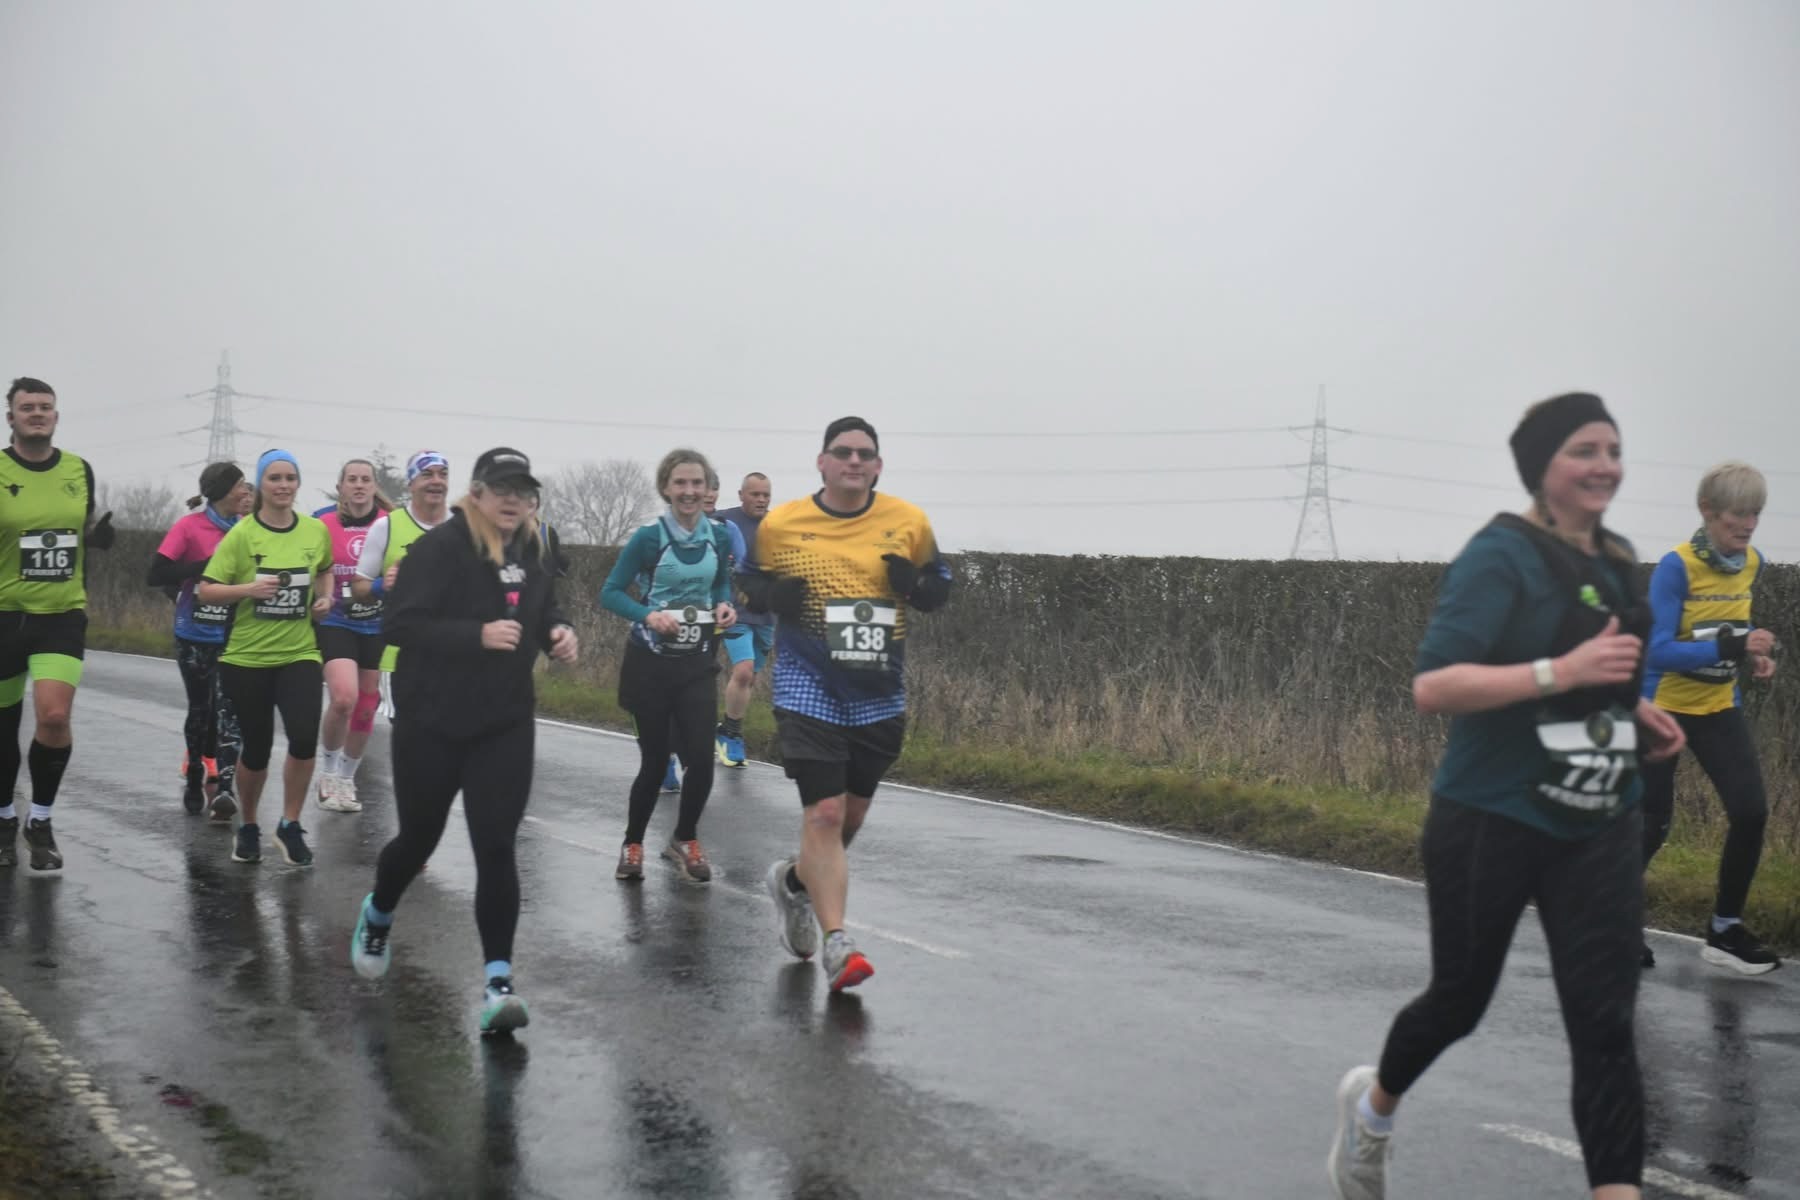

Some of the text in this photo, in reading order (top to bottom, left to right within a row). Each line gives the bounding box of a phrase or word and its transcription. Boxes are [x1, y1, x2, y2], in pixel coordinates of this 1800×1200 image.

[31, 549, 69, 568] 116
[676, 625, 702, 643] 99
[841, 626, 885, 650] 138
[831, 650, 878, 661] FERRIBY
